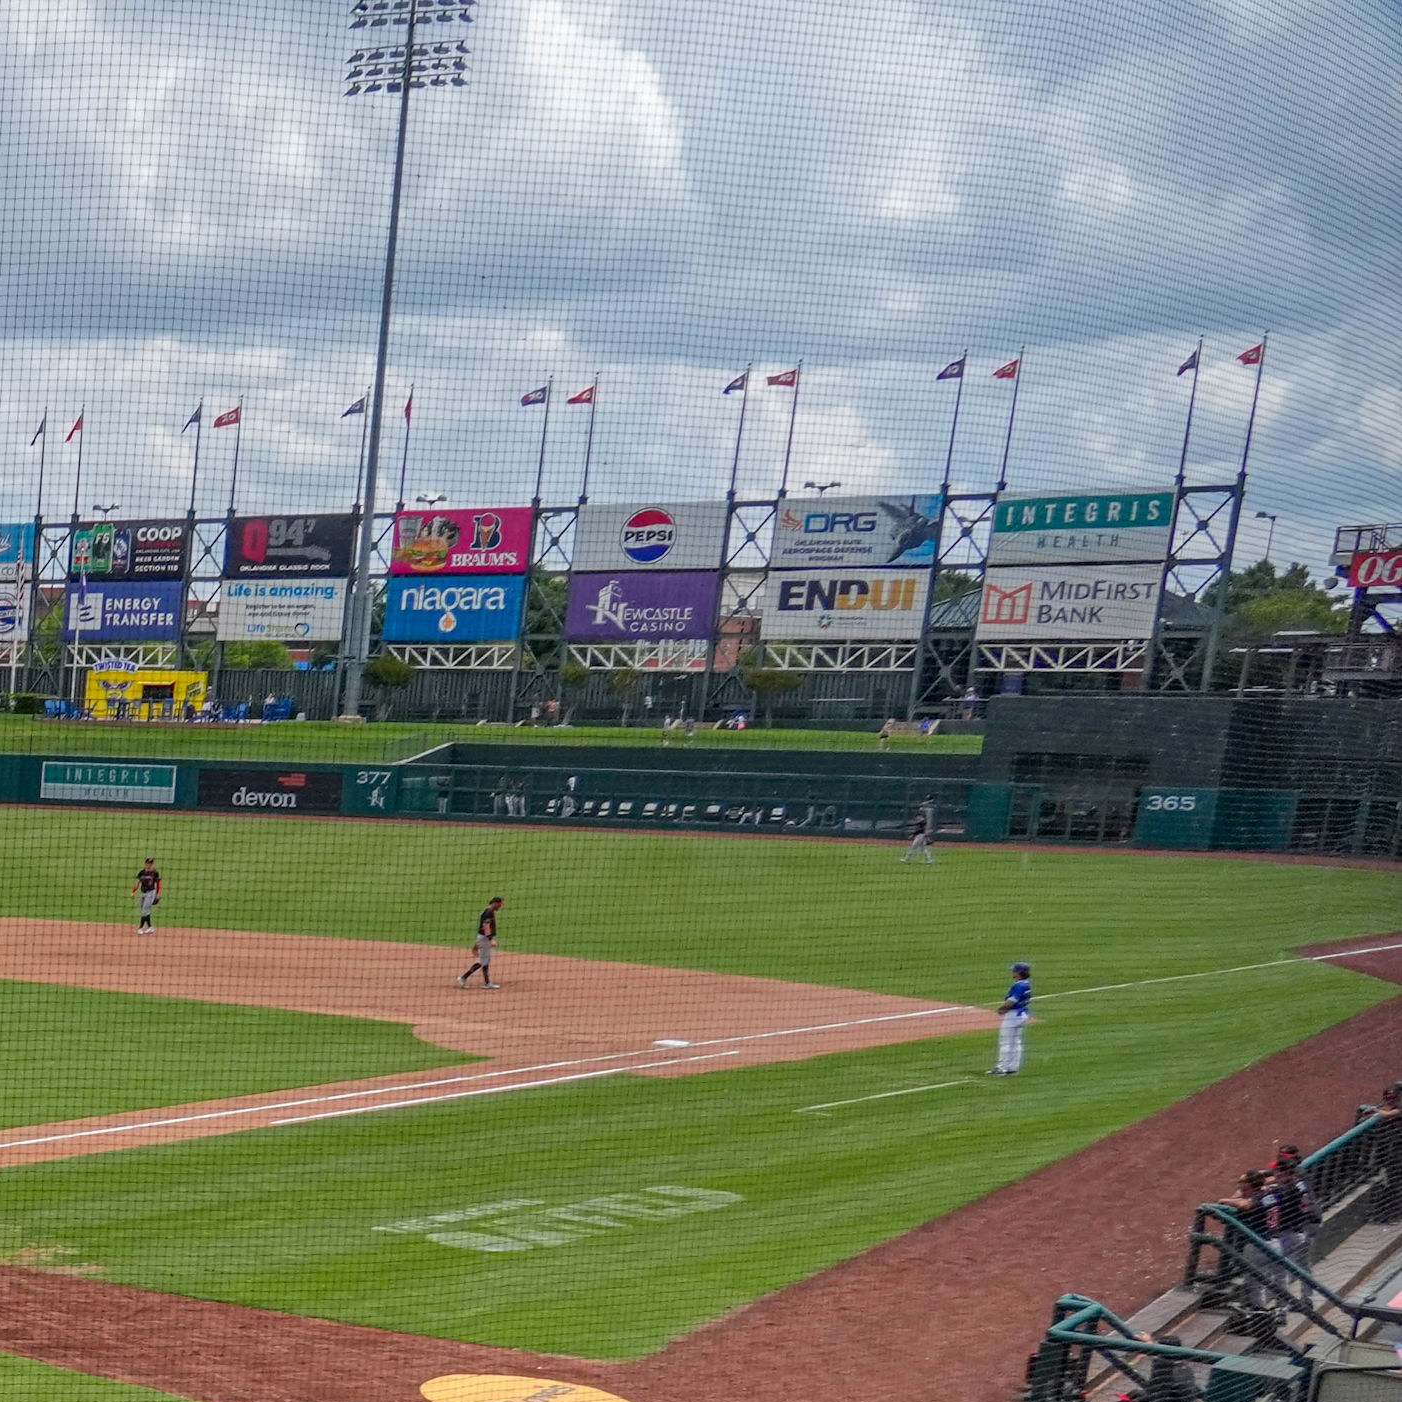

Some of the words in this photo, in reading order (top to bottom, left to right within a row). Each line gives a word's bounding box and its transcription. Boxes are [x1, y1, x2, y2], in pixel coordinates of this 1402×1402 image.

[1006, 500, 1160, 526] INTEGRIS
[804, 512, 878, 534] DRG
[137, 527, 182, 541] COOP
[624, 530, 673, 542] PEPSI
[1037, 534, 1119, 548] HEALTH
[227, 584, 251, 597] Life
[255, 585, 266, 596] is
[269, 583, 338, 599] amazing.
[400, 585, 506, 613] niagara
[778, 578, 918, 611] ENDUI
[105, 598, 161, 610] ENERGY
[586, 592, 693, 631] NEWCASTLE
[105, 613, 173, 626] TRANSFER
[629, 622, 685, 632] CASINO
[96, 660, 122, 670] TWISTED
[65, 767, 151, 784] INTEGRIS
[356, 771, 392, 784] 377
[231, 787, 297, 808] devon
[1146, 795, 1196, 811] 365
